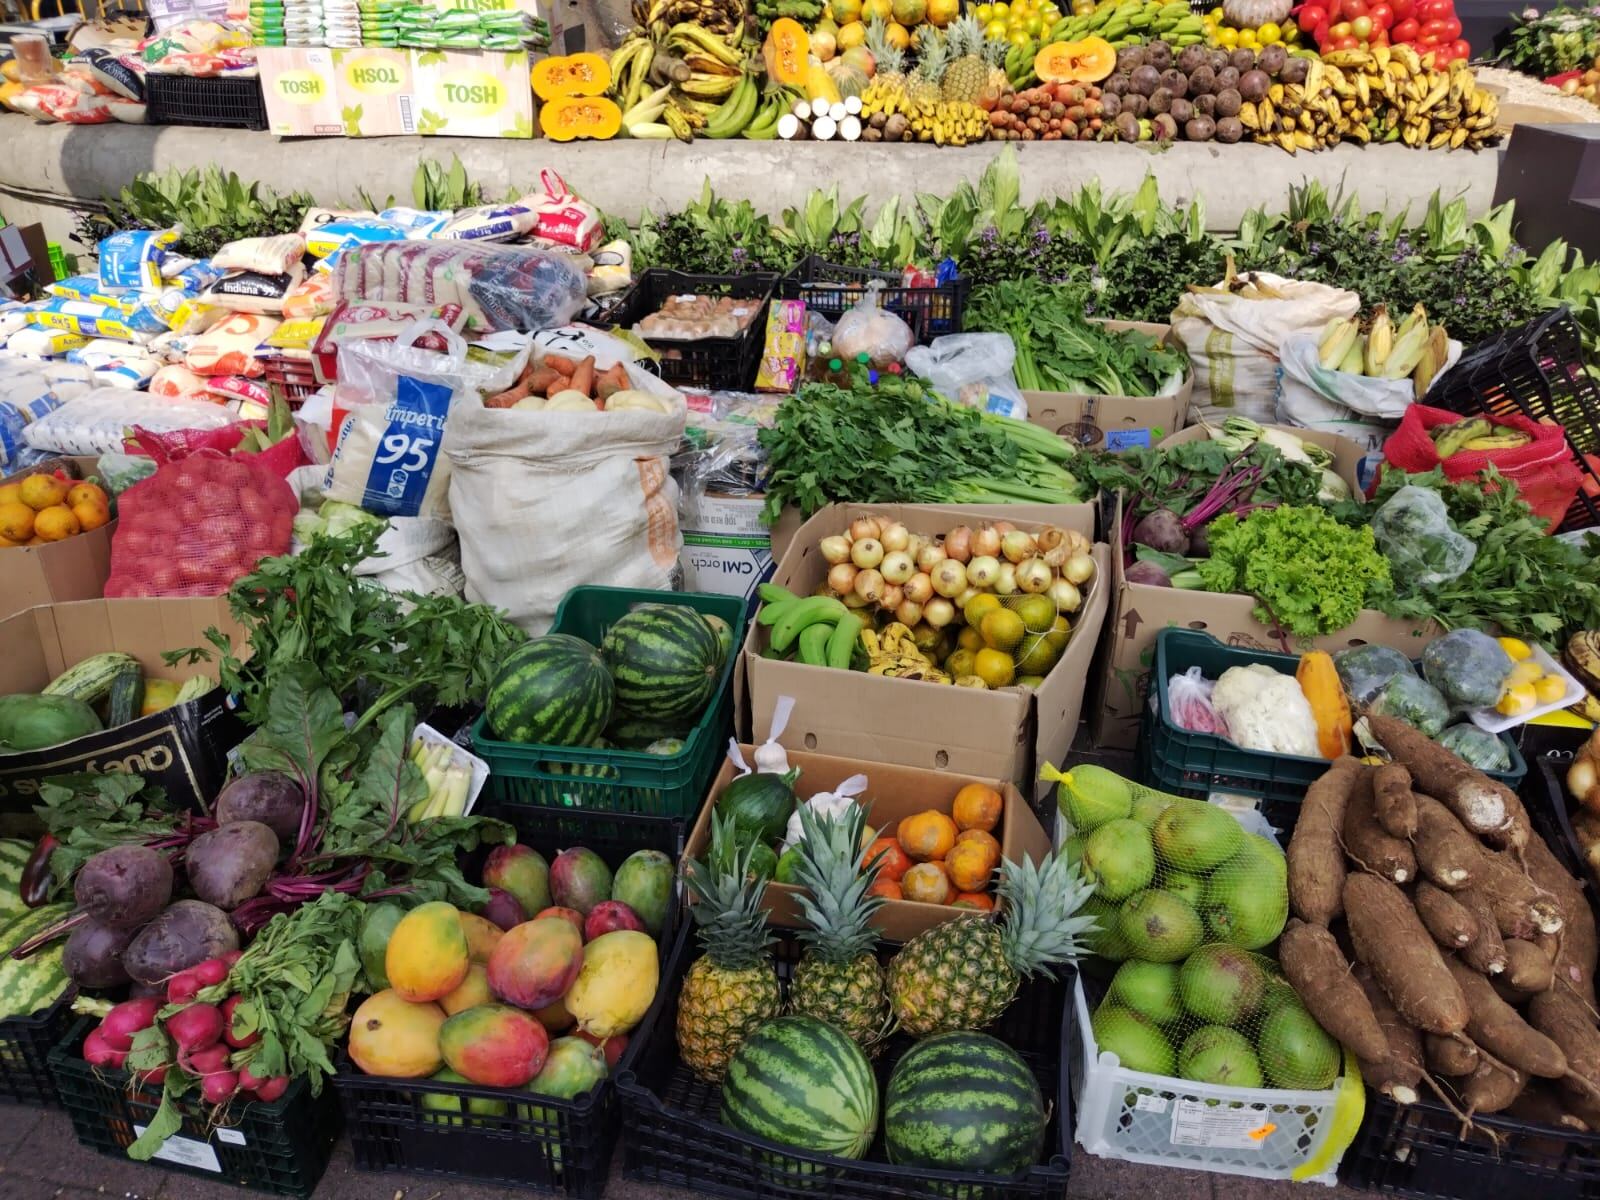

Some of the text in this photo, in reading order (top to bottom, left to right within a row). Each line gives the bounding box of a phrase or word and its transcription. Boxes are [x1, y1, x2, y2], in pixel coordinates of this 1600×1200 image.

[353, 68, 400, 83] TOSH
[279, 80, 320, 94] TOSH
[443, 84, 498, 104] TOSH
[224, 282, 258, 294] Indiana
[376, 434, 434, 472] 95
[723, 561, 753, 574] CMI
